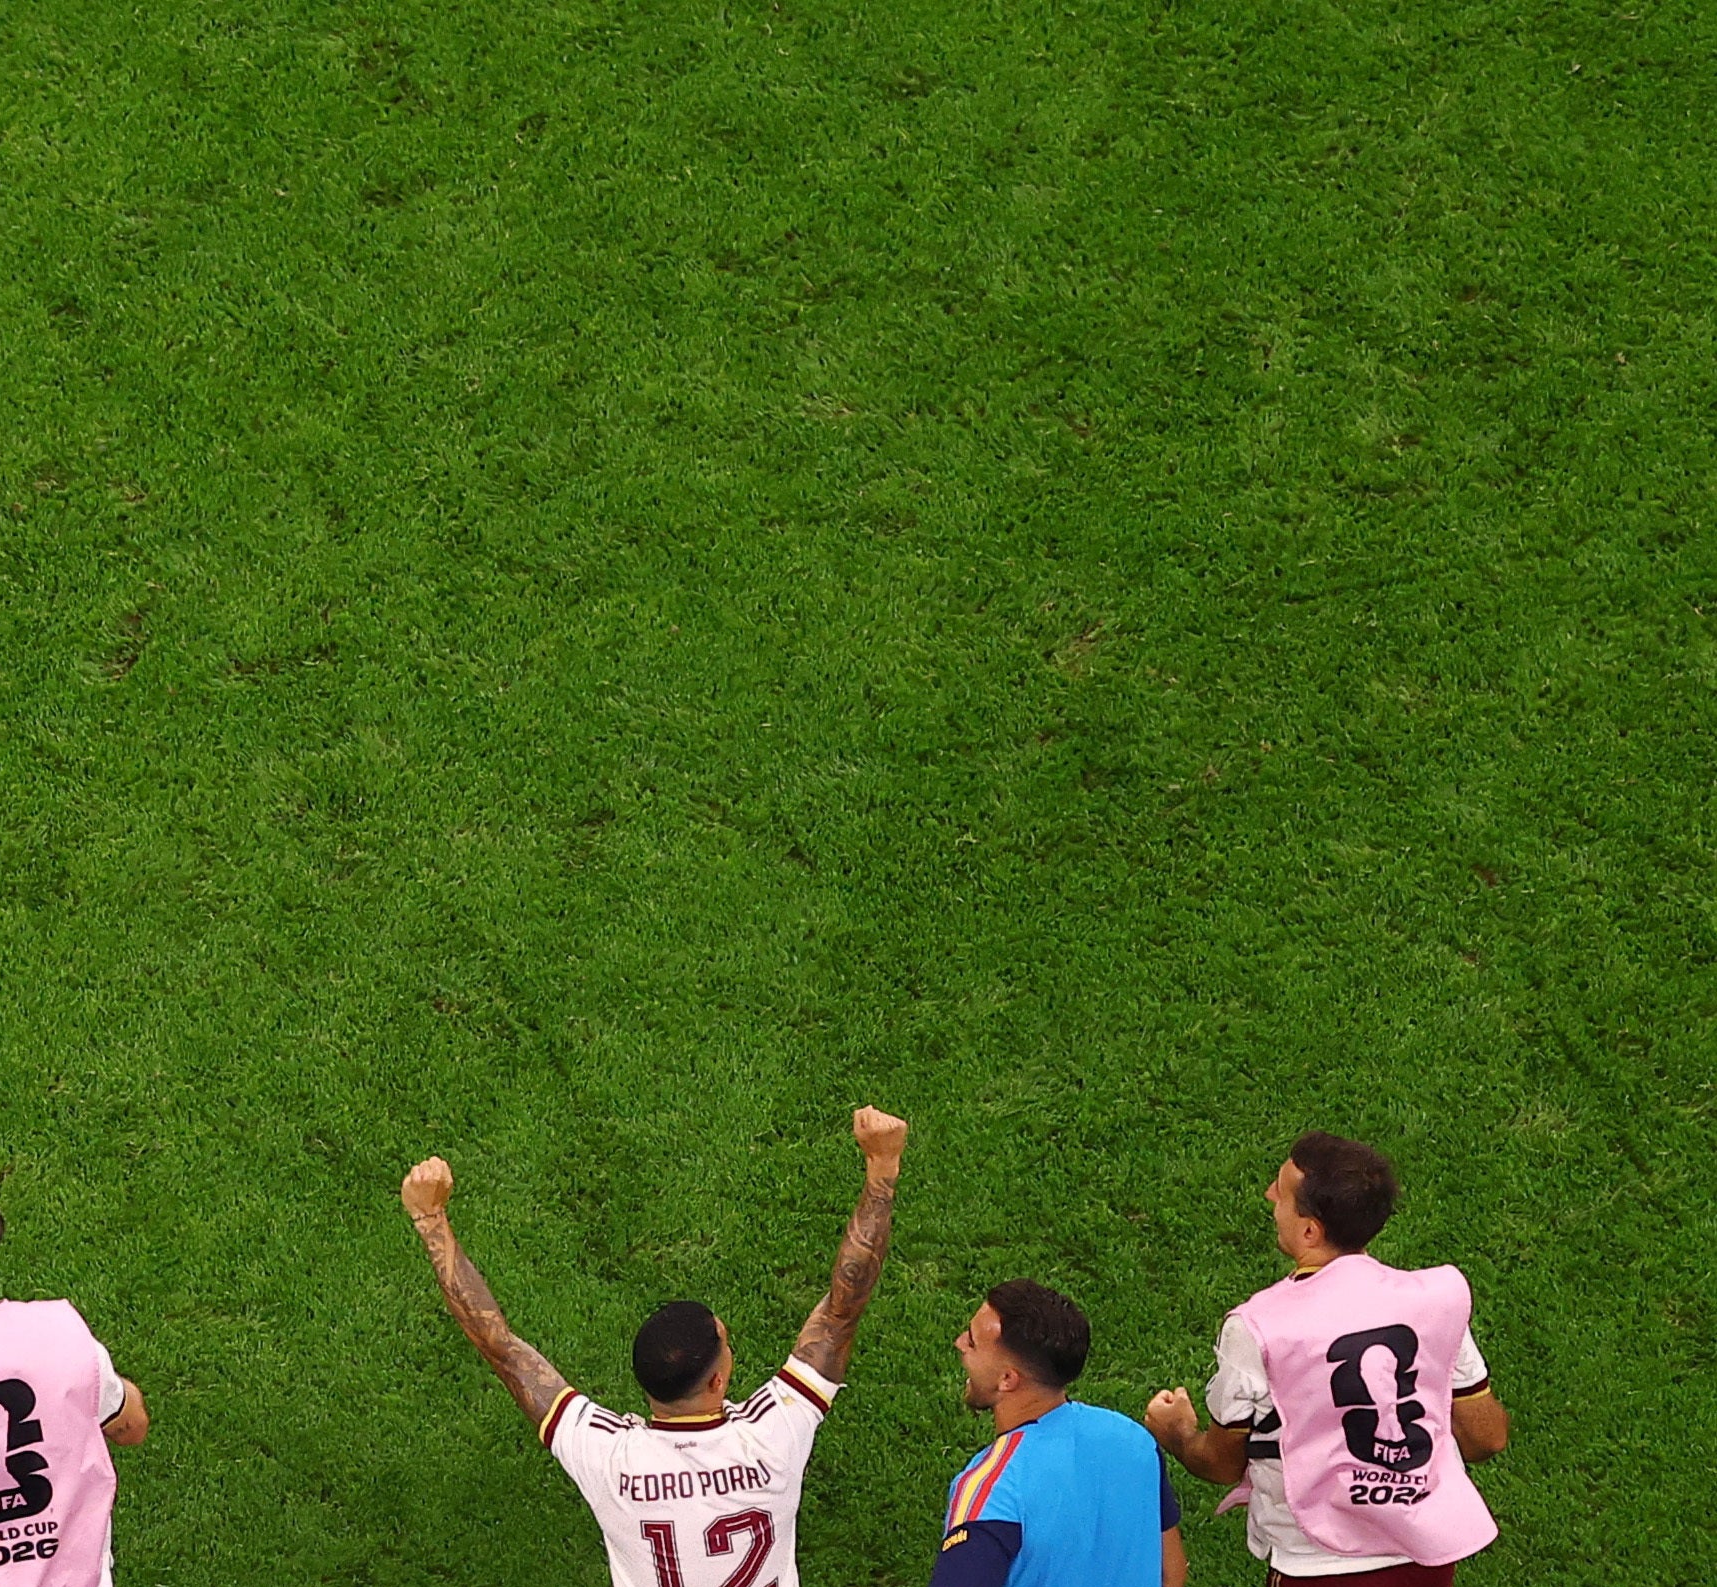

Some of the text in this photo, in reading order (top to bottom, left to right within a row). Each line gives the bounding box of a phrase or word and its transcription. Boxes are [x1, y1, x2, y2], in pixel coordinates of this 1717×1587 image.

[1373, 1441, 1411, 1464] FIFA
[619, 1471, 693, 1501] PEDRO
[1352, 1469, 1411, 1485] WORLD
[24, 1521, 59, 1538] CUP
